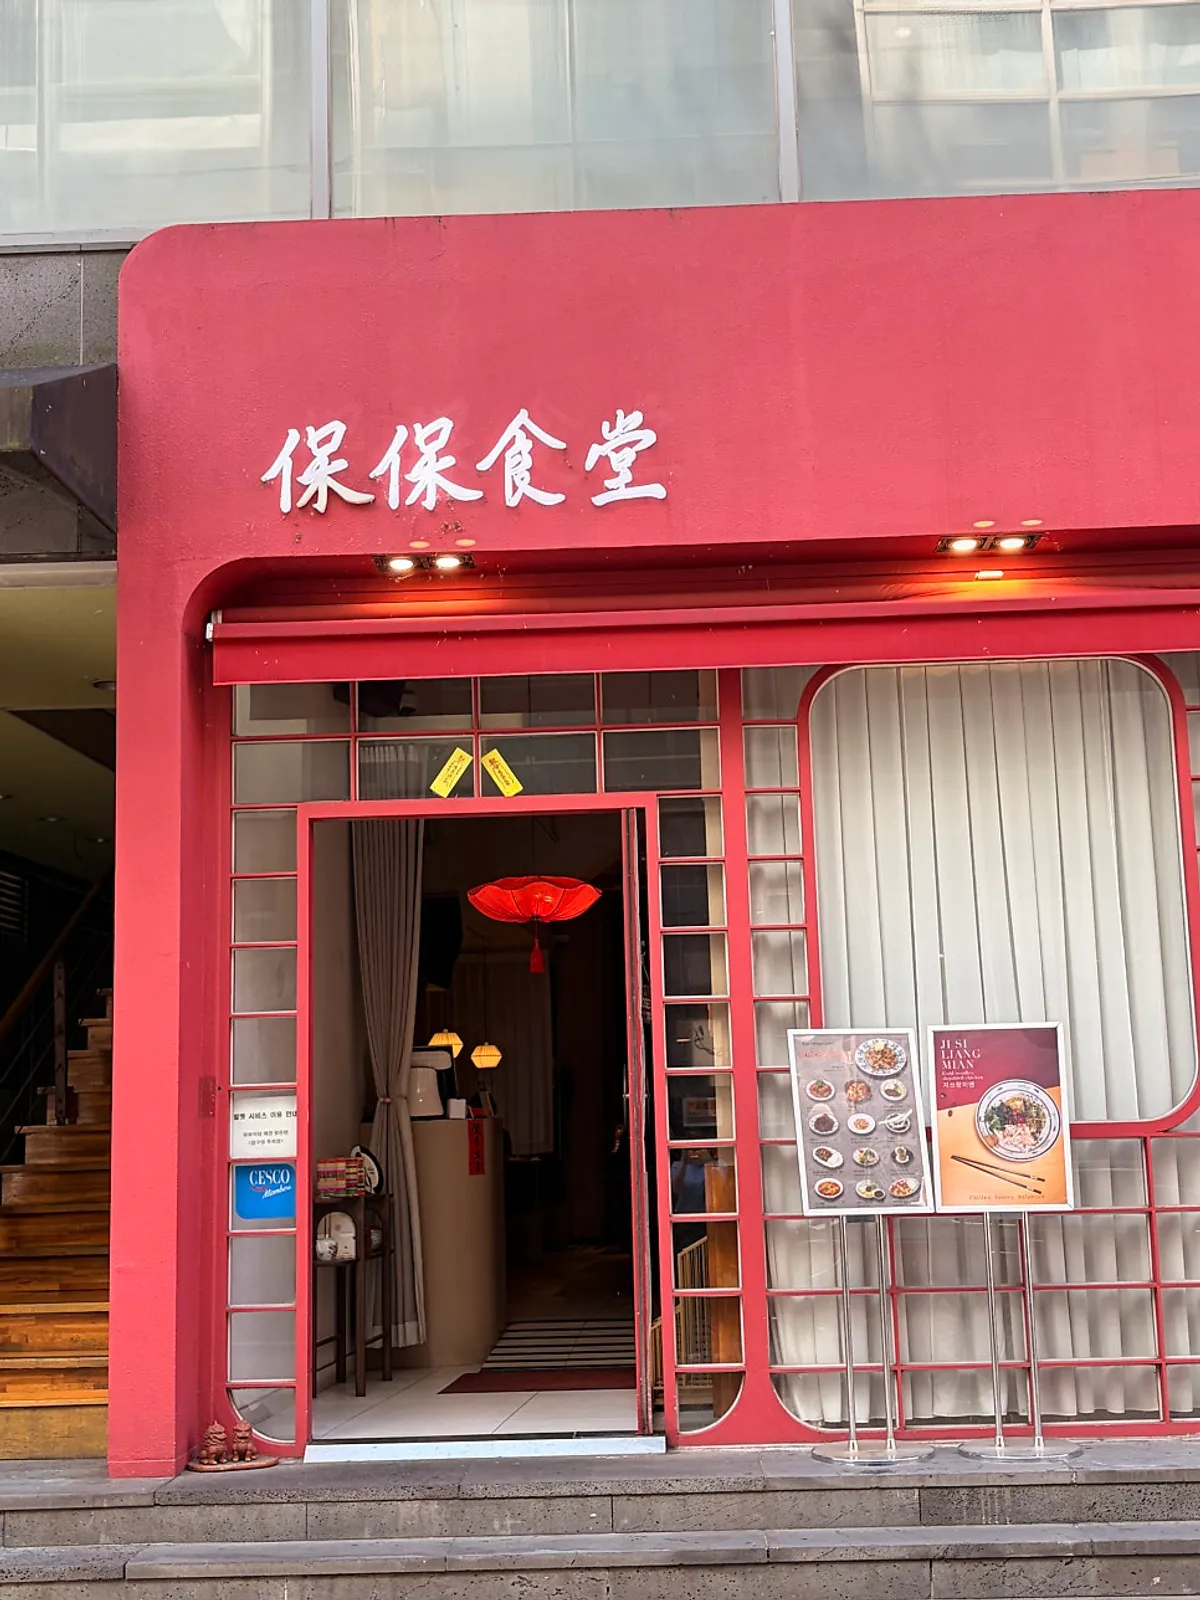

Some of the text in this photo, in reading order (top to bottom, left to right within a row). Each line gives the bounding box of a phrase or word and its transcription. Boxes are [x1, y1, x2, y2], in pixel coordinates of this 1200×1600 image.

[261, 408, 668, 514] 保保食堂
[940, 1038, 967, 1049] JI SI
[941, 1048, 981, 1060] LIANG
[942, 1059, 974, 1070] MIAN
[249, 1169, 290, 1186] CESCO
